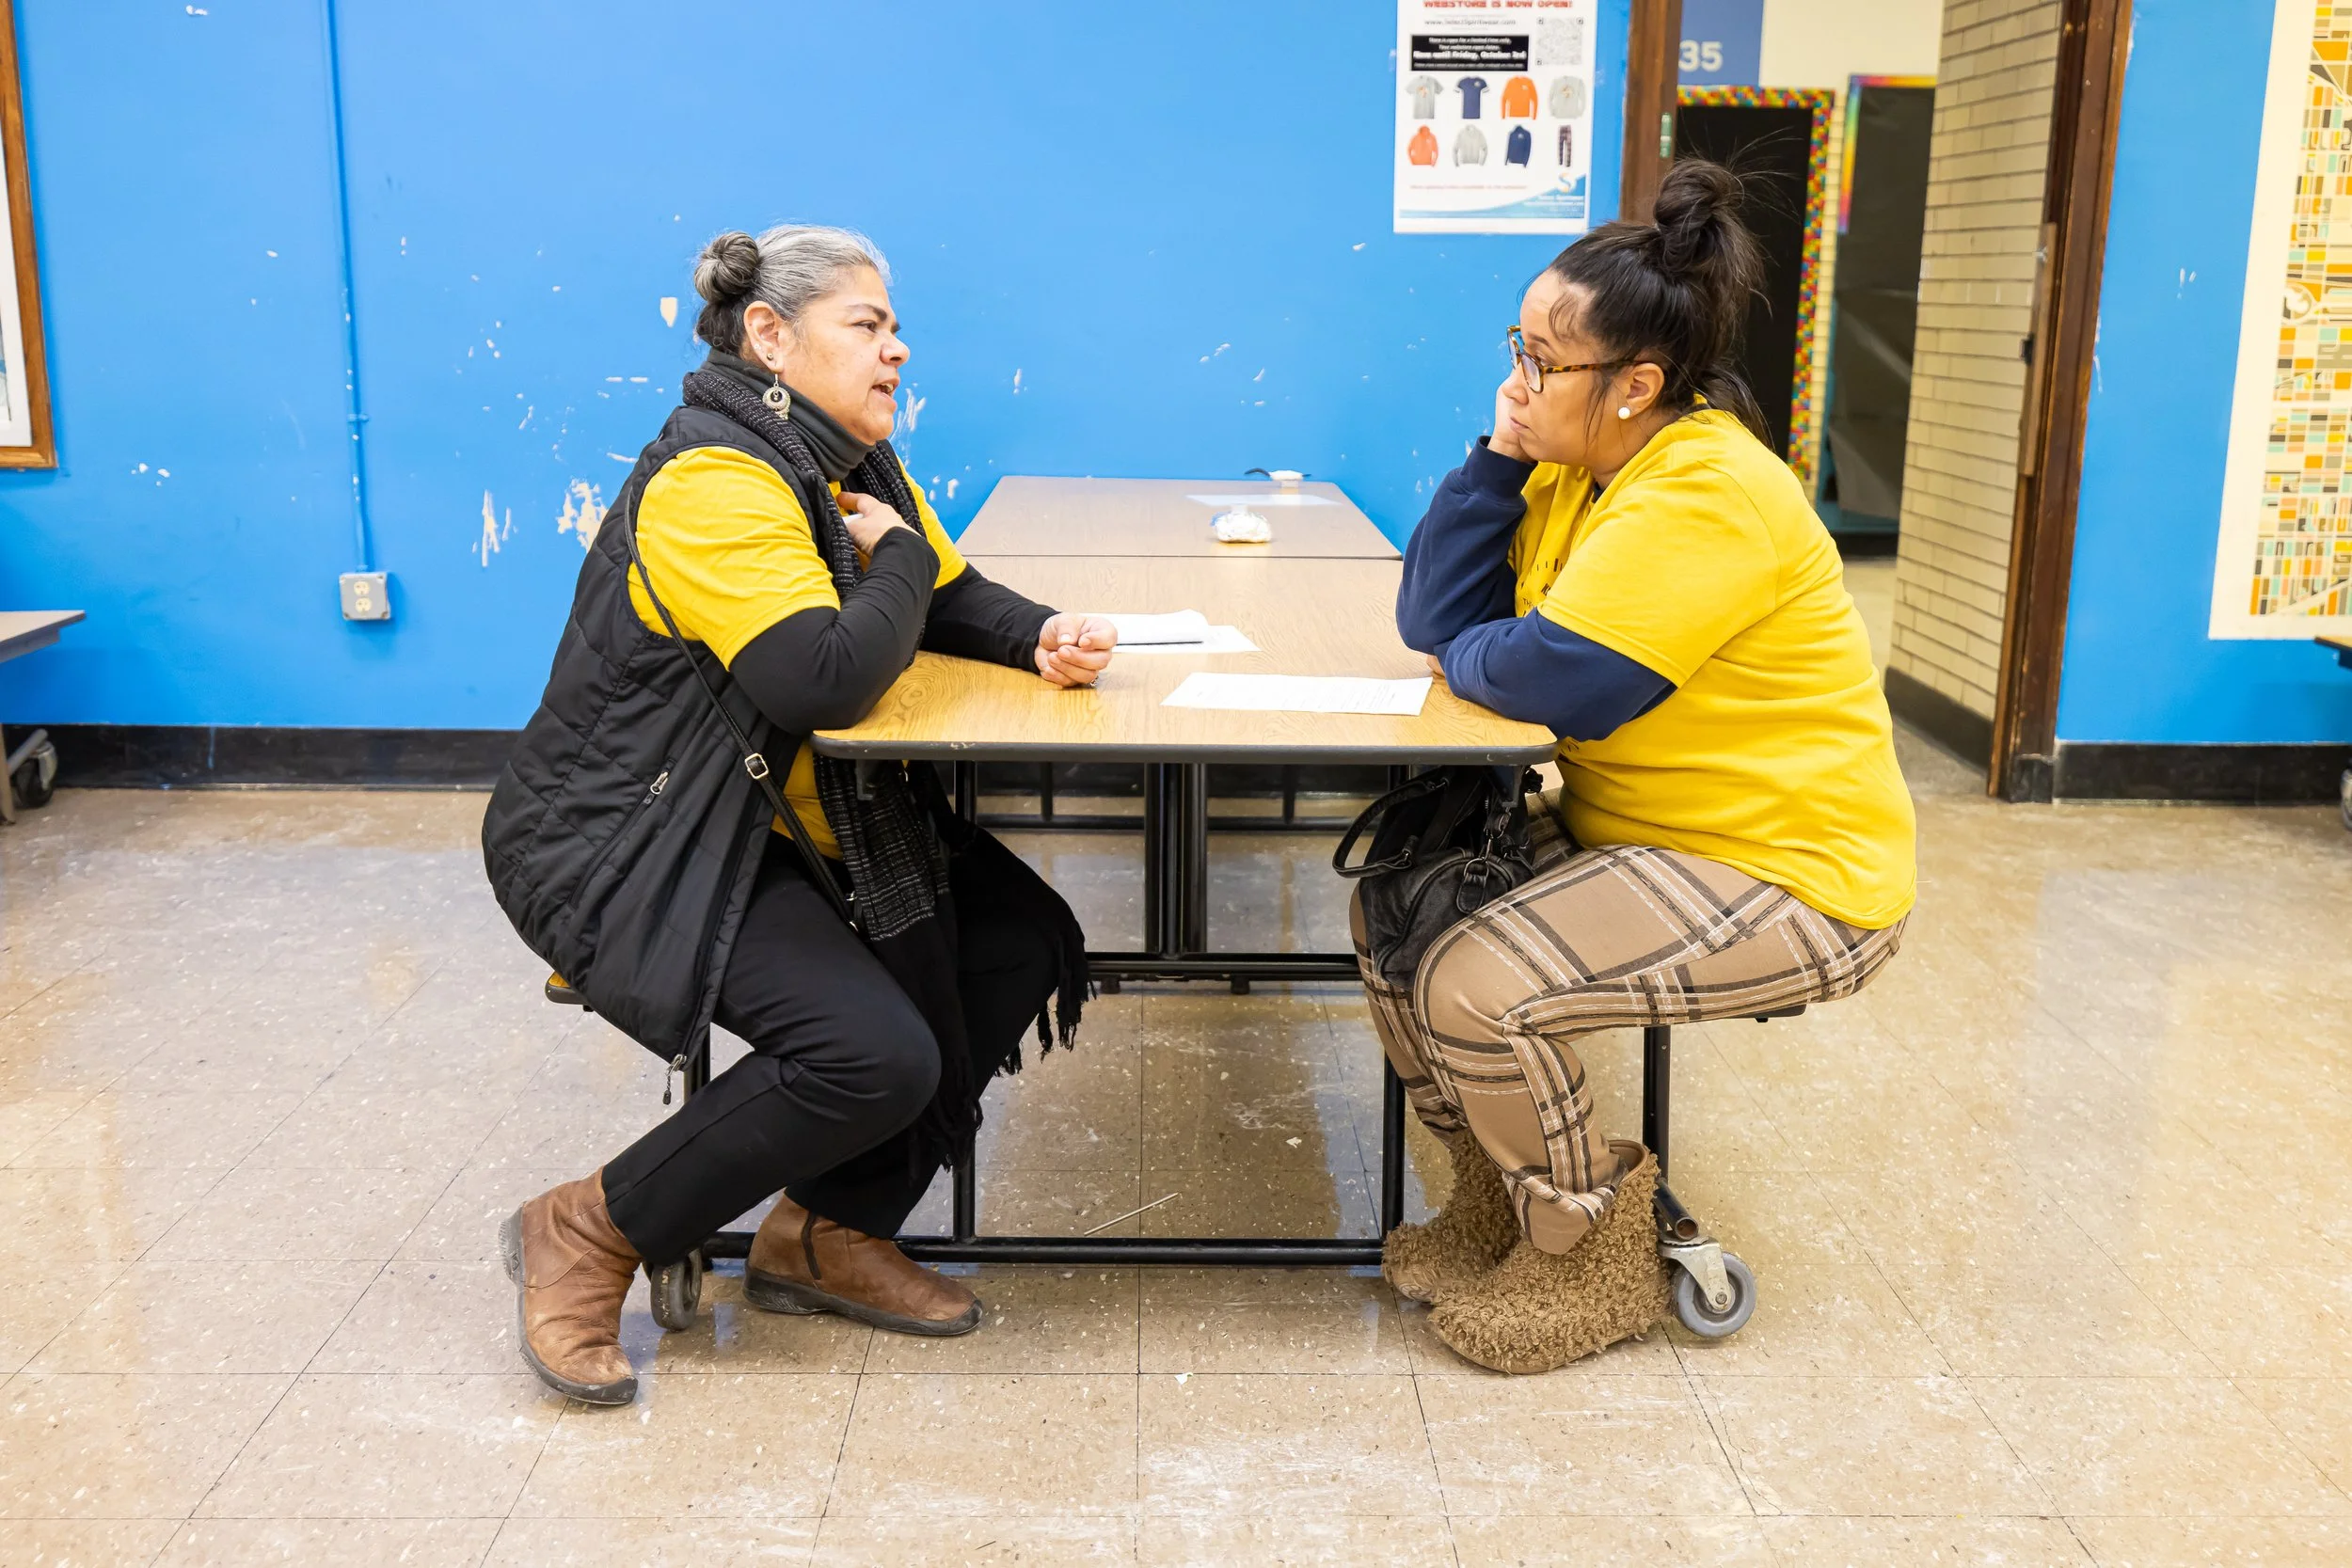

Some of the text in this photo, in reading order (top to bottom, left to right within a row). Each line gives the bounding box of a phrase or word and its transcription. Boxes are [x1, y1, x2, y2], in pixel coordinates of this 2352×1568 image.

[1413, 50, 1431, 58] Now
[1432, 50, 1451, 58] until
[1452, 50, 1480, 61] Friday,
[1480, 50, 1511, 59] October
[1678, 39, 1723, 72] 35
